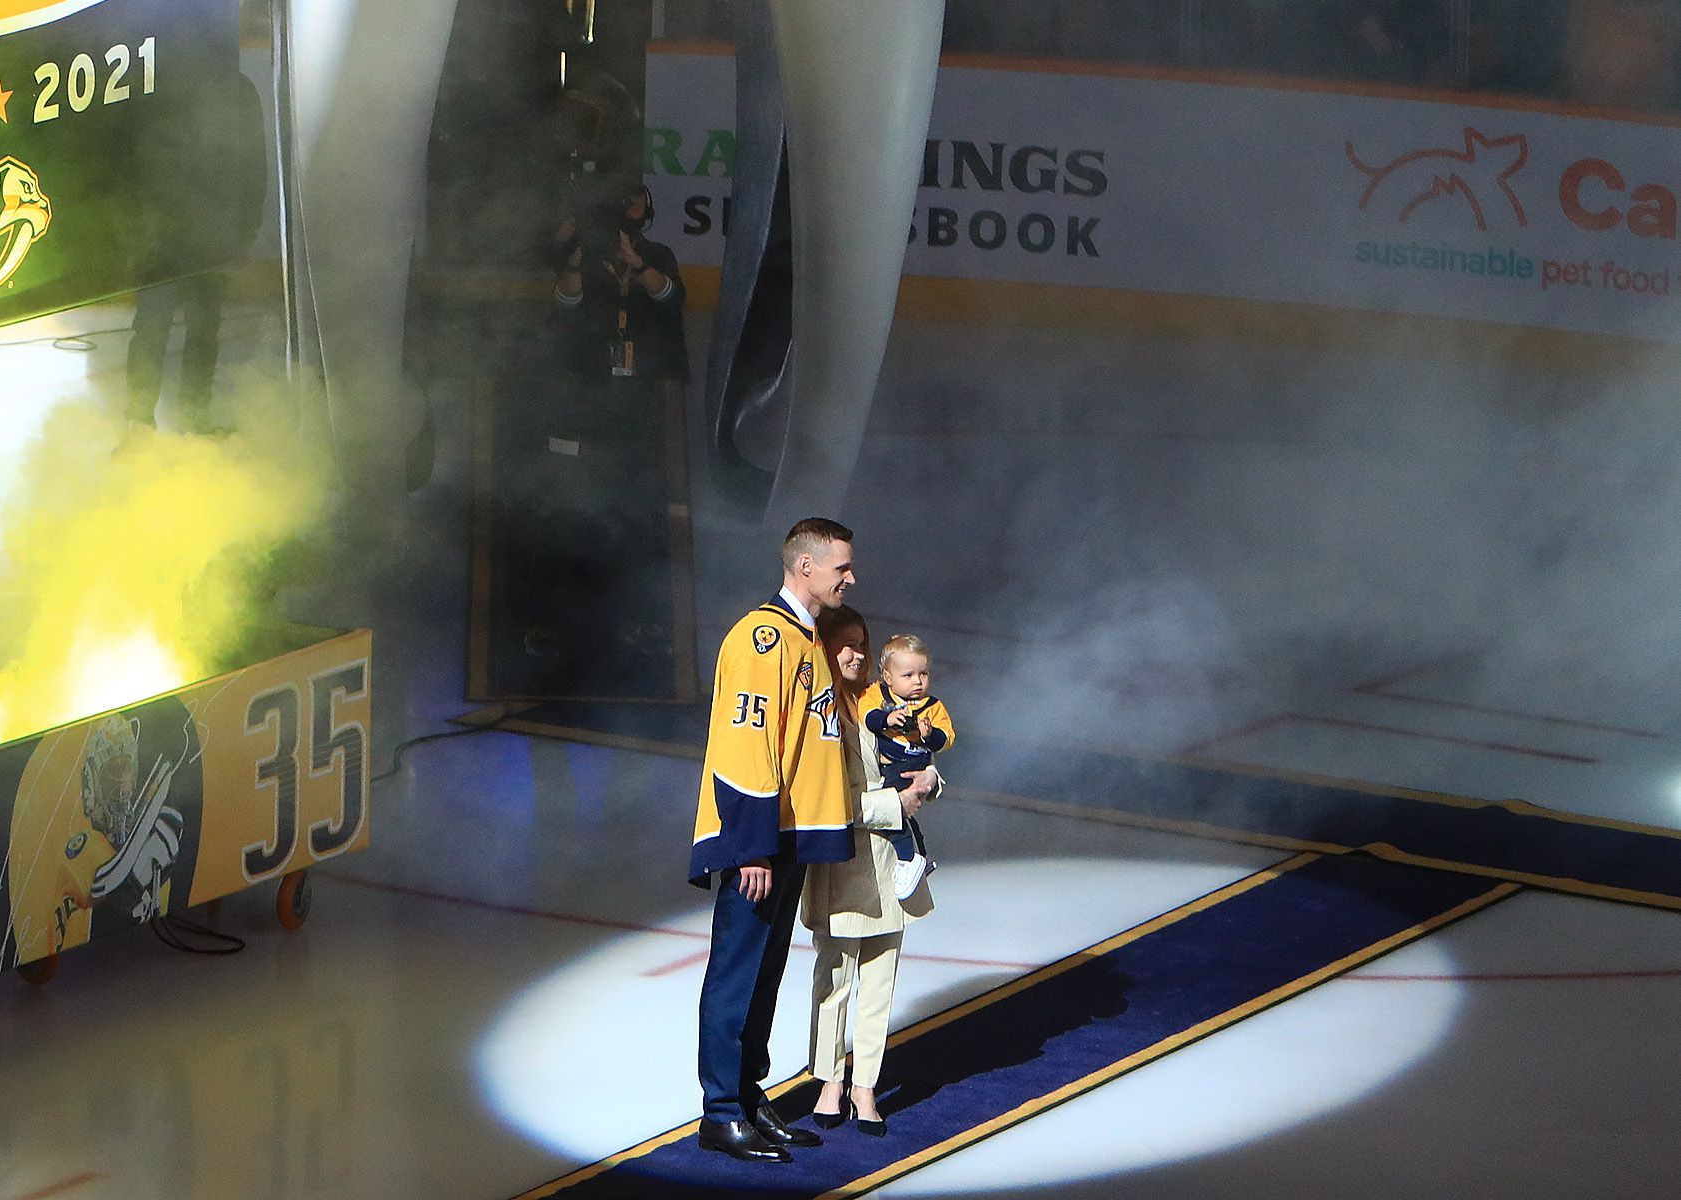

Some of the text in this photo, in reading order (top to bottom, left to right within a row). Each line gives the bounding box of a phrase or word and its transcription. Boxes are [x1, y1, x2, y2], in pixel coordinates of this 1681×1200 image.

[32, 36, 156, 124] 2021
[1558, 157, 1679, 240] Ca
[1355, 240, 1670, 295] sustainable pet food
[732, 692, 768, 729] 35
[241, 657, 370, 884] 35
